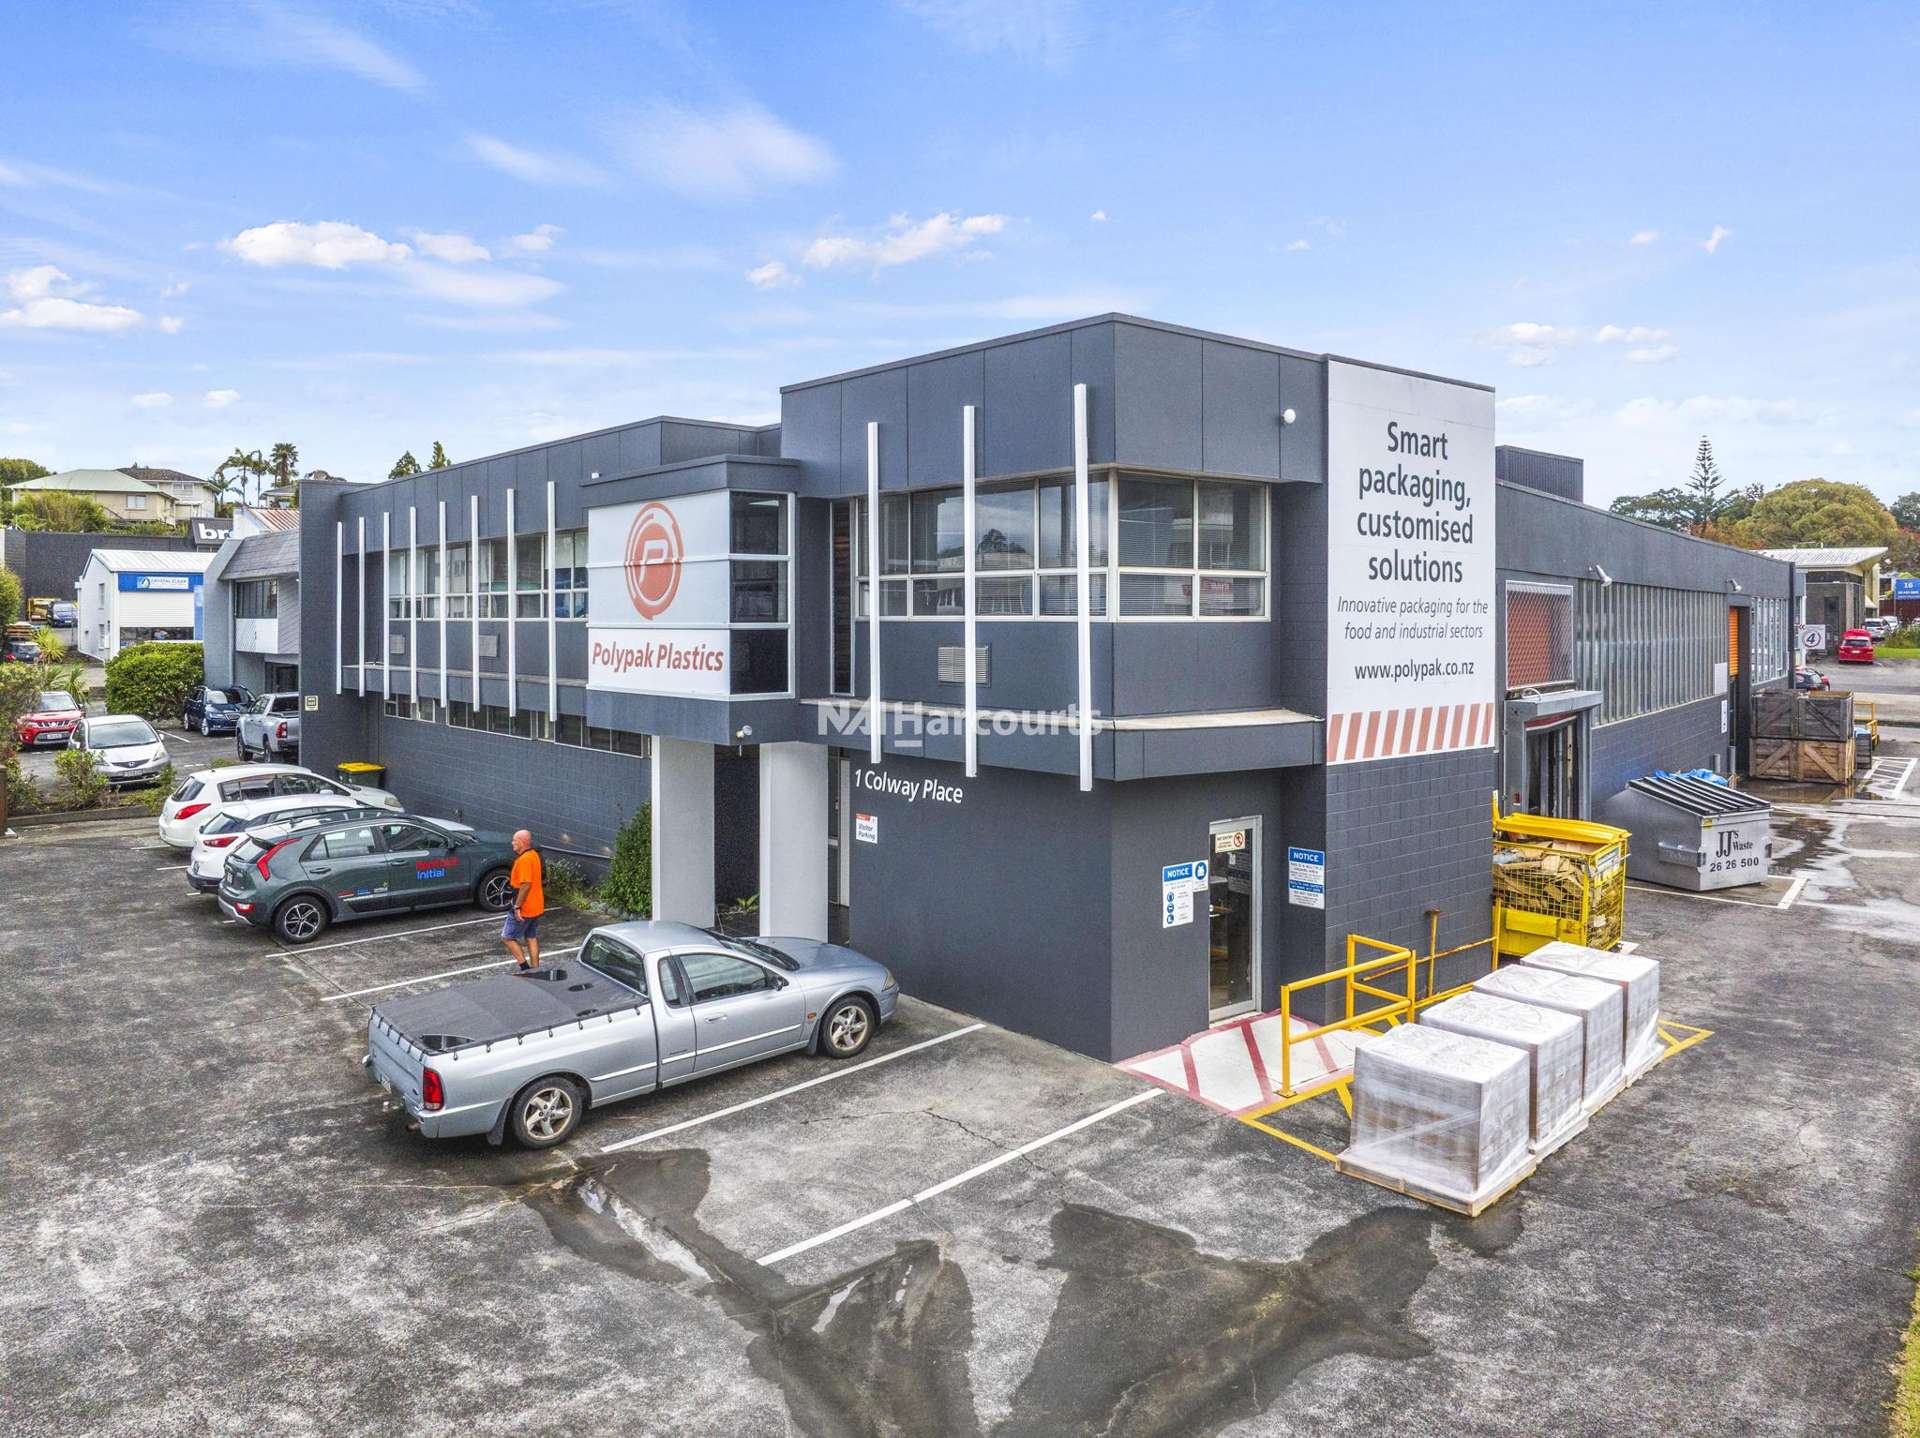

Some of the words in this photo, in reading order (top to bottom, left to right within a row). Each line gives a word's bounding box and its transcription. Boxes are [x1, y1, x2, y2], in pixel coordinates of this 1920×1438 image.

[1387, 421, 1448, 460] Smart
[1359, 463, 1471, 512] packaging,
[198, 522, 231, 540] br
[1357, 510, 1473, 544] customised
[1368, 548, 1463, 583] solutions
[1337, 595, 1397, 613] Innovative
[1399, 597, 1453, 618] packaging
[1455, 597, 1470, 614] for
[1472, 598, 1488, 614] the
[1344, 622, 1372, 640] food
[1374, 622, 1397, 640] and
[1399, 622, 1448, 639] industrial
[1449, 624, 1483, 639] sectors
[592, 640, 654, 673] Polypak
[656, 642, 724, 671] Plastics
[1354, 657, 1474, 683] www.polypak.co.nz
[855, 769, 862, 788] 1
[864, 769, 920, 803] Colway
[922, 778, 964, 804] Place
[1293, 851, 1319, 863] NOTICE
[1733, 841, 1754, 851] Waste
[1167, 867, 1190, 879] NOTICE
[1710, 862, 1722, 872] 26
[1726, 860, 1737, 870] 26
[1740, 857, 1759, 868] 500
